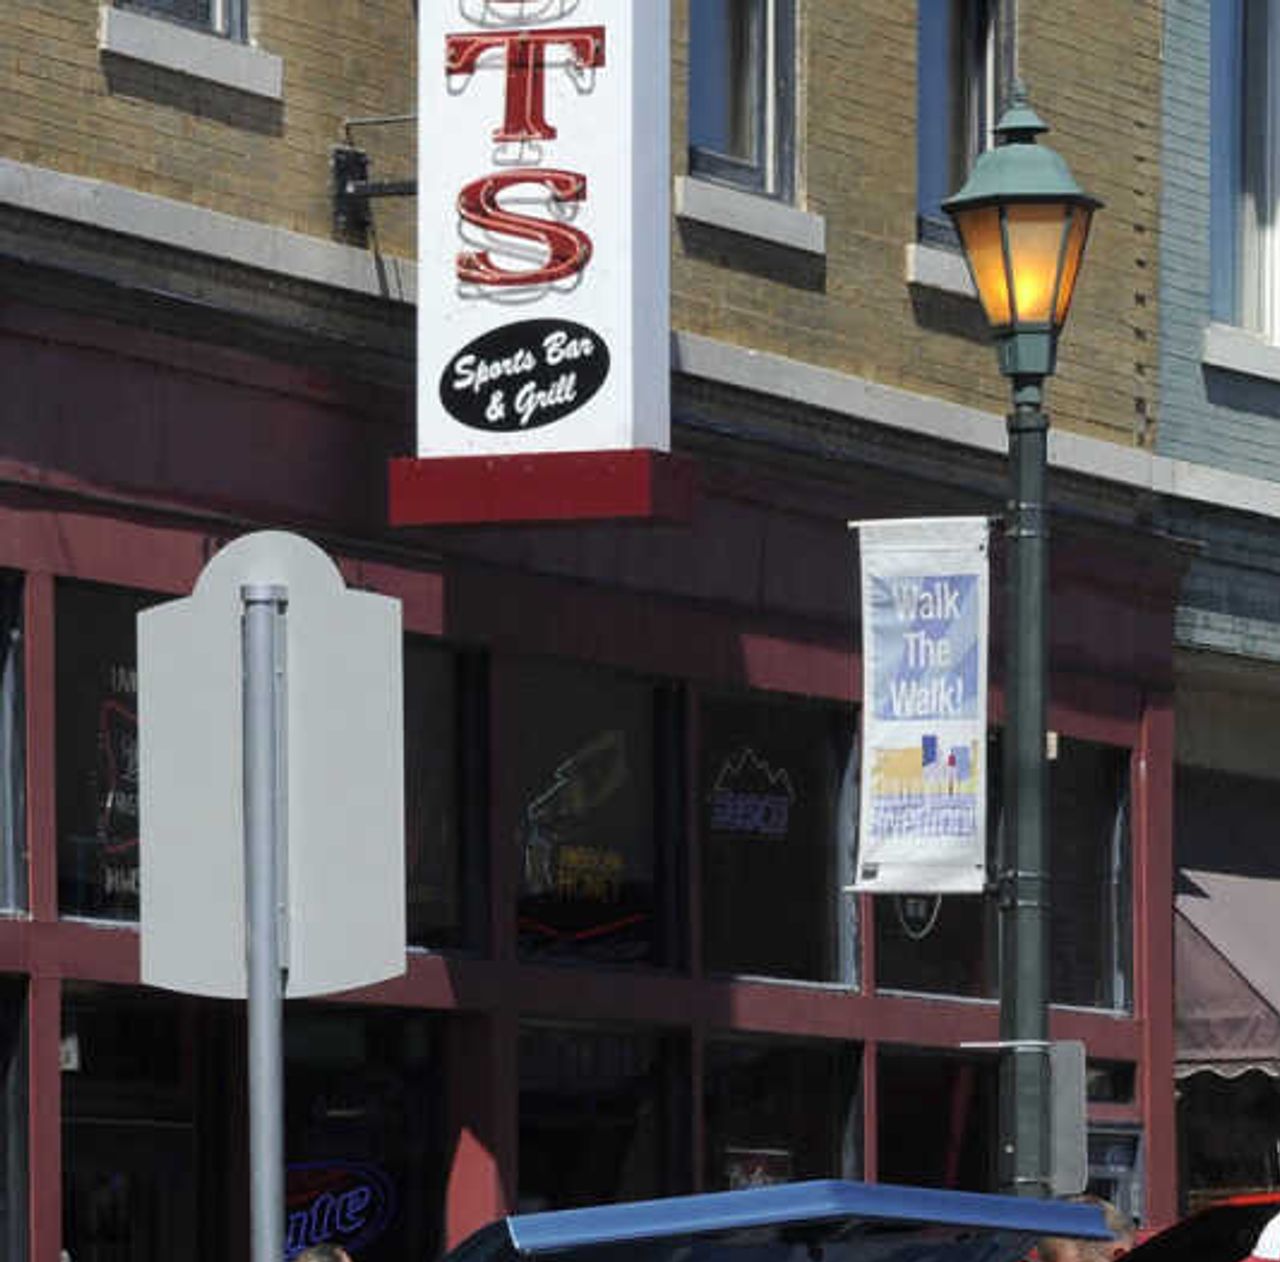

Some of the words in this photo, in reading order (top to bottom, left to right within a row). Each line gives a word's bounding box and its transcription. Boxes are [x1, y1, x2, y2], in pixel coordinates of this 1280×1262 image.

[444, 0, 606, 287] TS
[453, 348, 537, 393] Sports
[542, 331, 594, 366] Bar
[484, 391, 506, 423] &
[513, 372, 577, 425] Grill
[891, 584, 962, 620] Walk
[902, 630, 953, 669] The
[889, 678, 965, 717] Walk!
